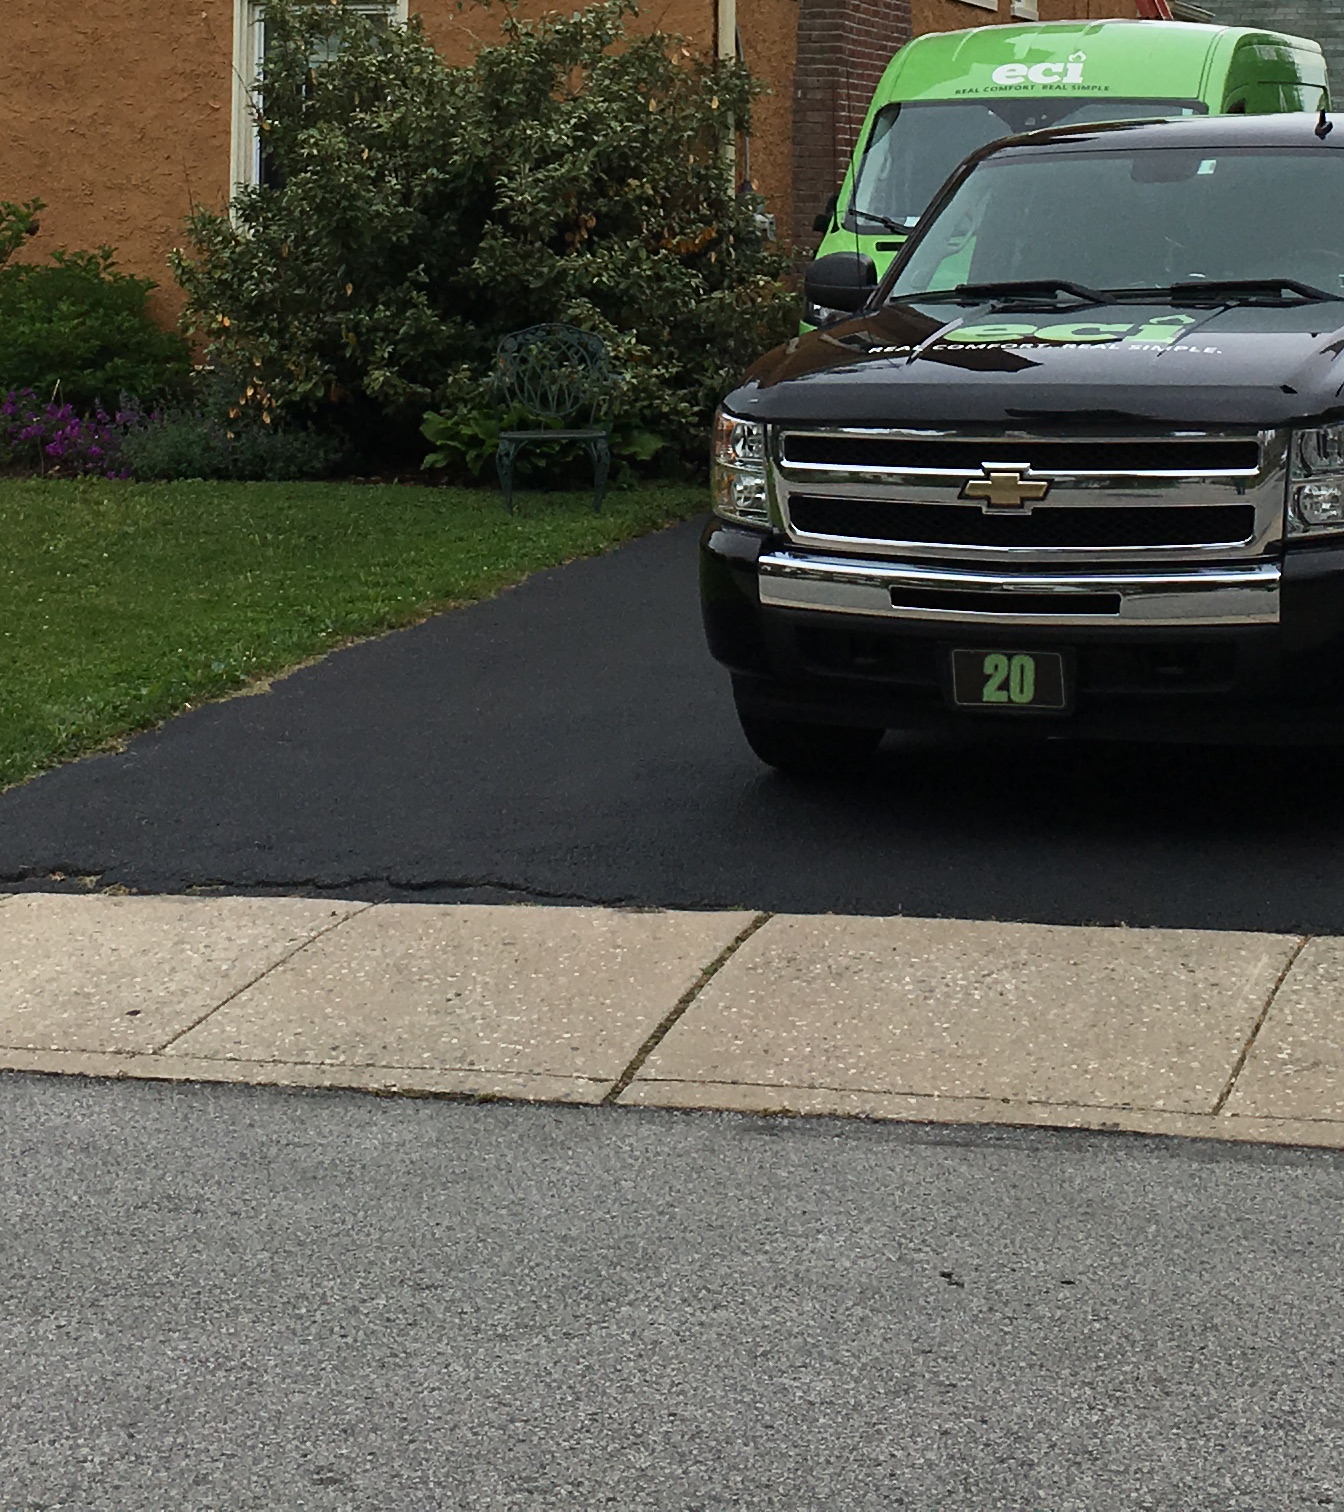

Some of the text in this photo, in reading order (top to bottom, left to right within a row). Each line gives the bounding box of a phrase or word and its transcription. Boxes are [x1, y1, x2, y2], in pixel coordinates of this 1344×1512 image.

[992, 51, 1087, 85] eci
[954, 87, 980, 96] REAL
[982, 84, 1036, 93] COMFORT
[1071, 84, 1111, 92] SIMPLE
[943, 314, 1196, 344] eci
[868, 345, 923, 354] REAL
[982, 653, 1036, 704] 20
